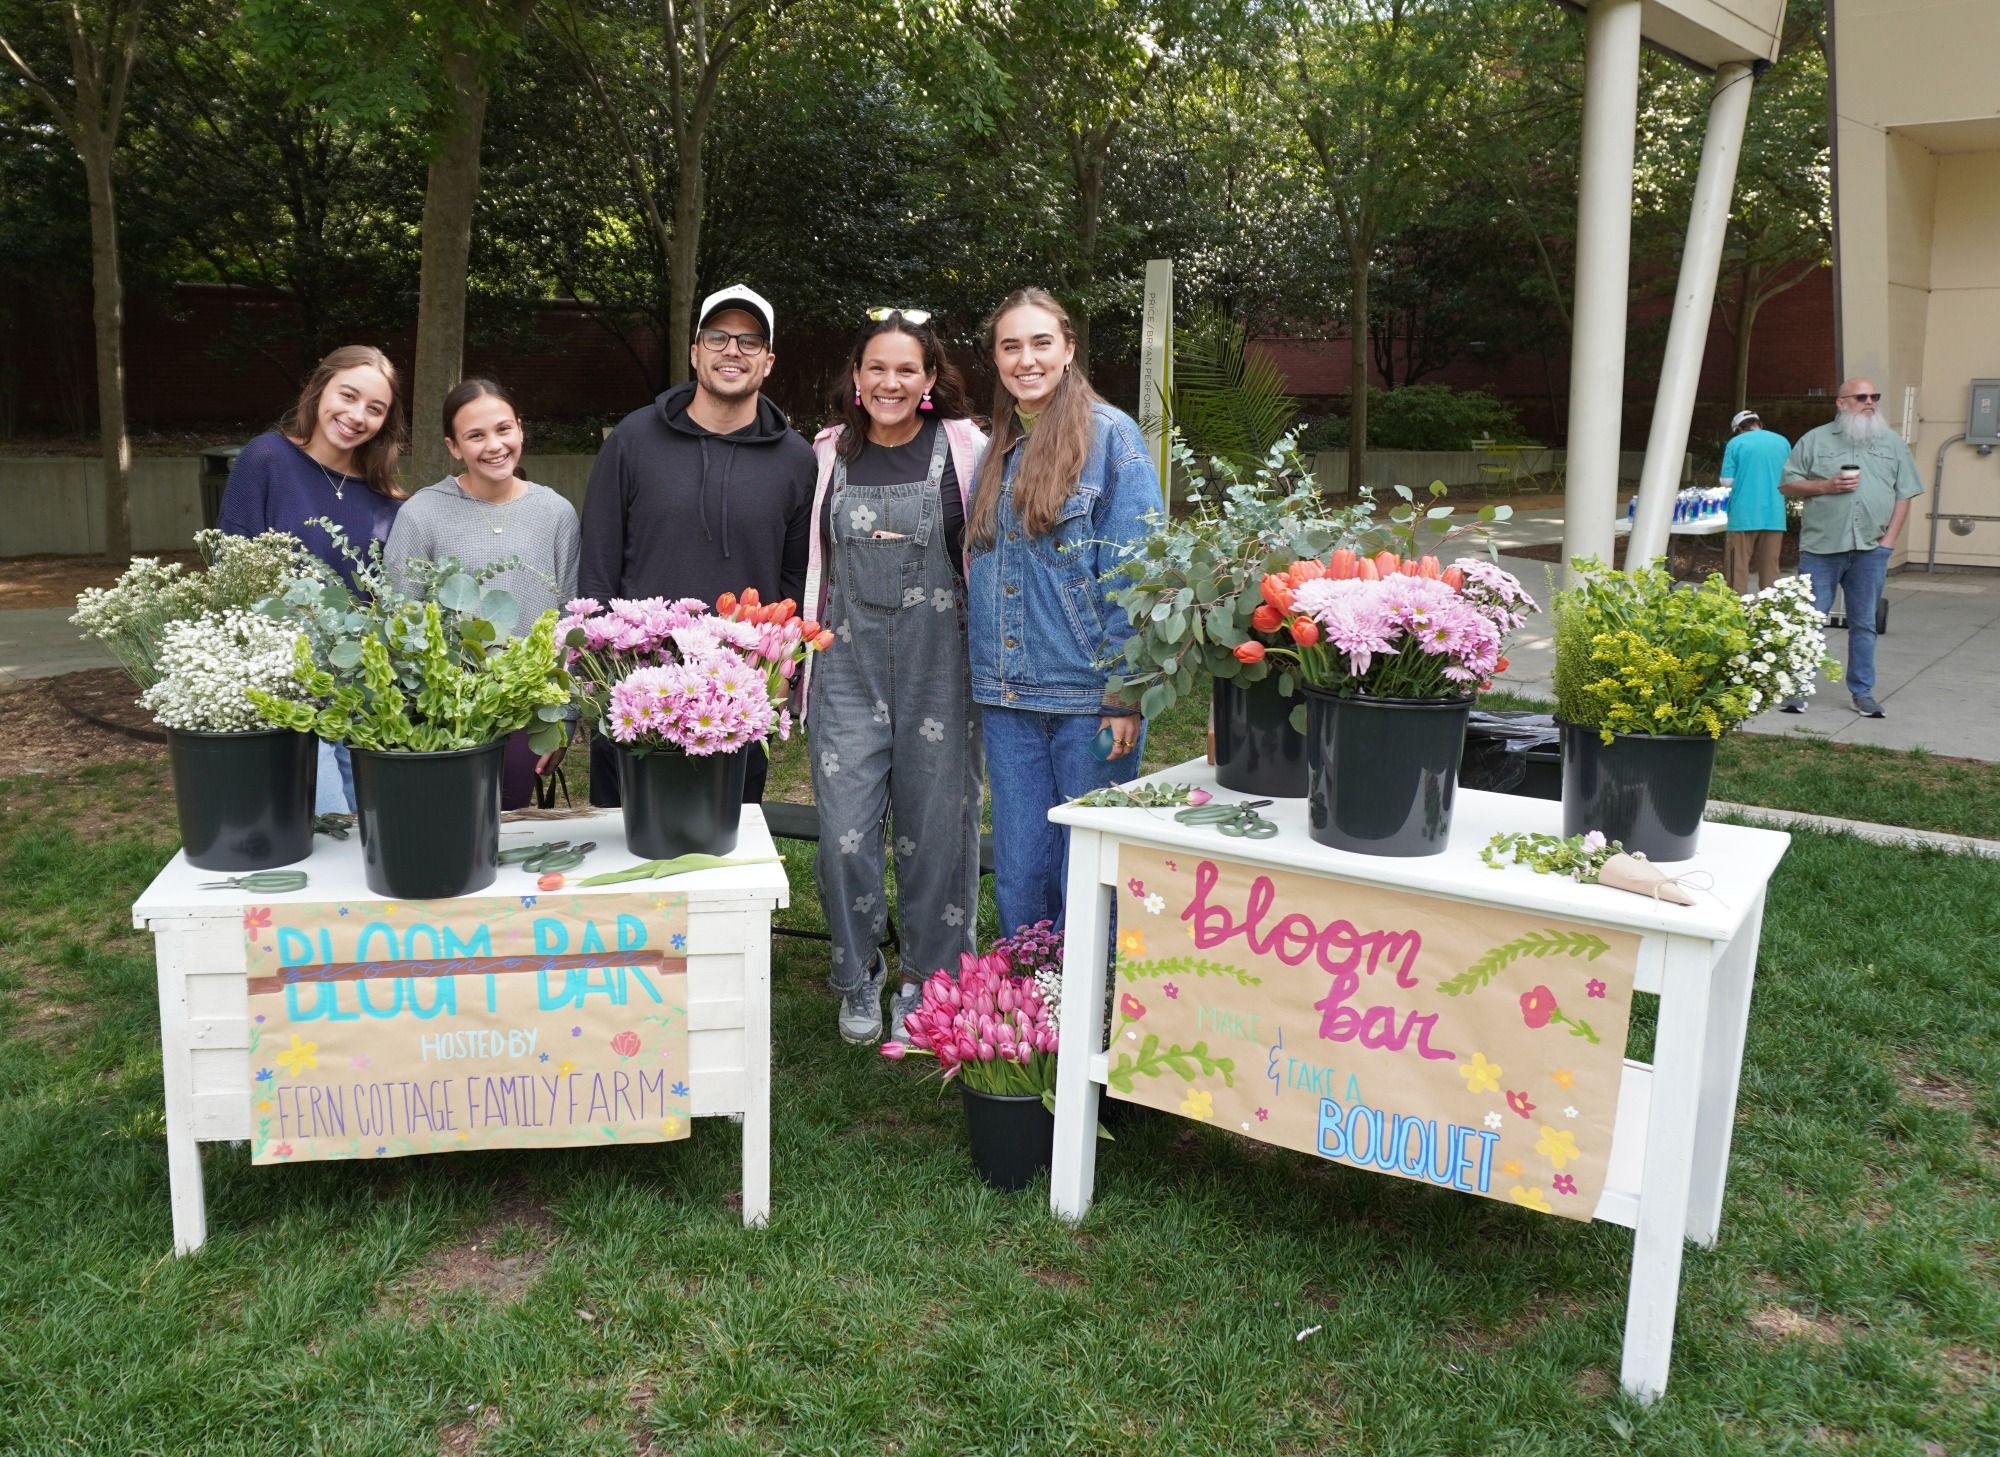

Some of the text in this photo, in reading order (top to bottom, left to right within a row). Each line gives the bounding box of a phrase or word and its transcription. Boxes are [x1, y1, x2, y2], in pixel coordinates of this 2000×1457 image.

[1181, 860, 1423, 989] bloom
[277, 913, 664, 1022] BLOOM BAR
[421, 1027, 538, 1061] HOSTED BY
[1198, 1003, 1264, 1045] MAKE
[1314, 971, 1457, 1061] bar
[277, 1068, 666, 1140] FERN COTTAGE FAMILY FARM
[1287, 1057, 1336, 1100] TAKE
[1345, 1072, 1362, 1104] A
[1317, 1097, 1501, 1194] BOUQUET
